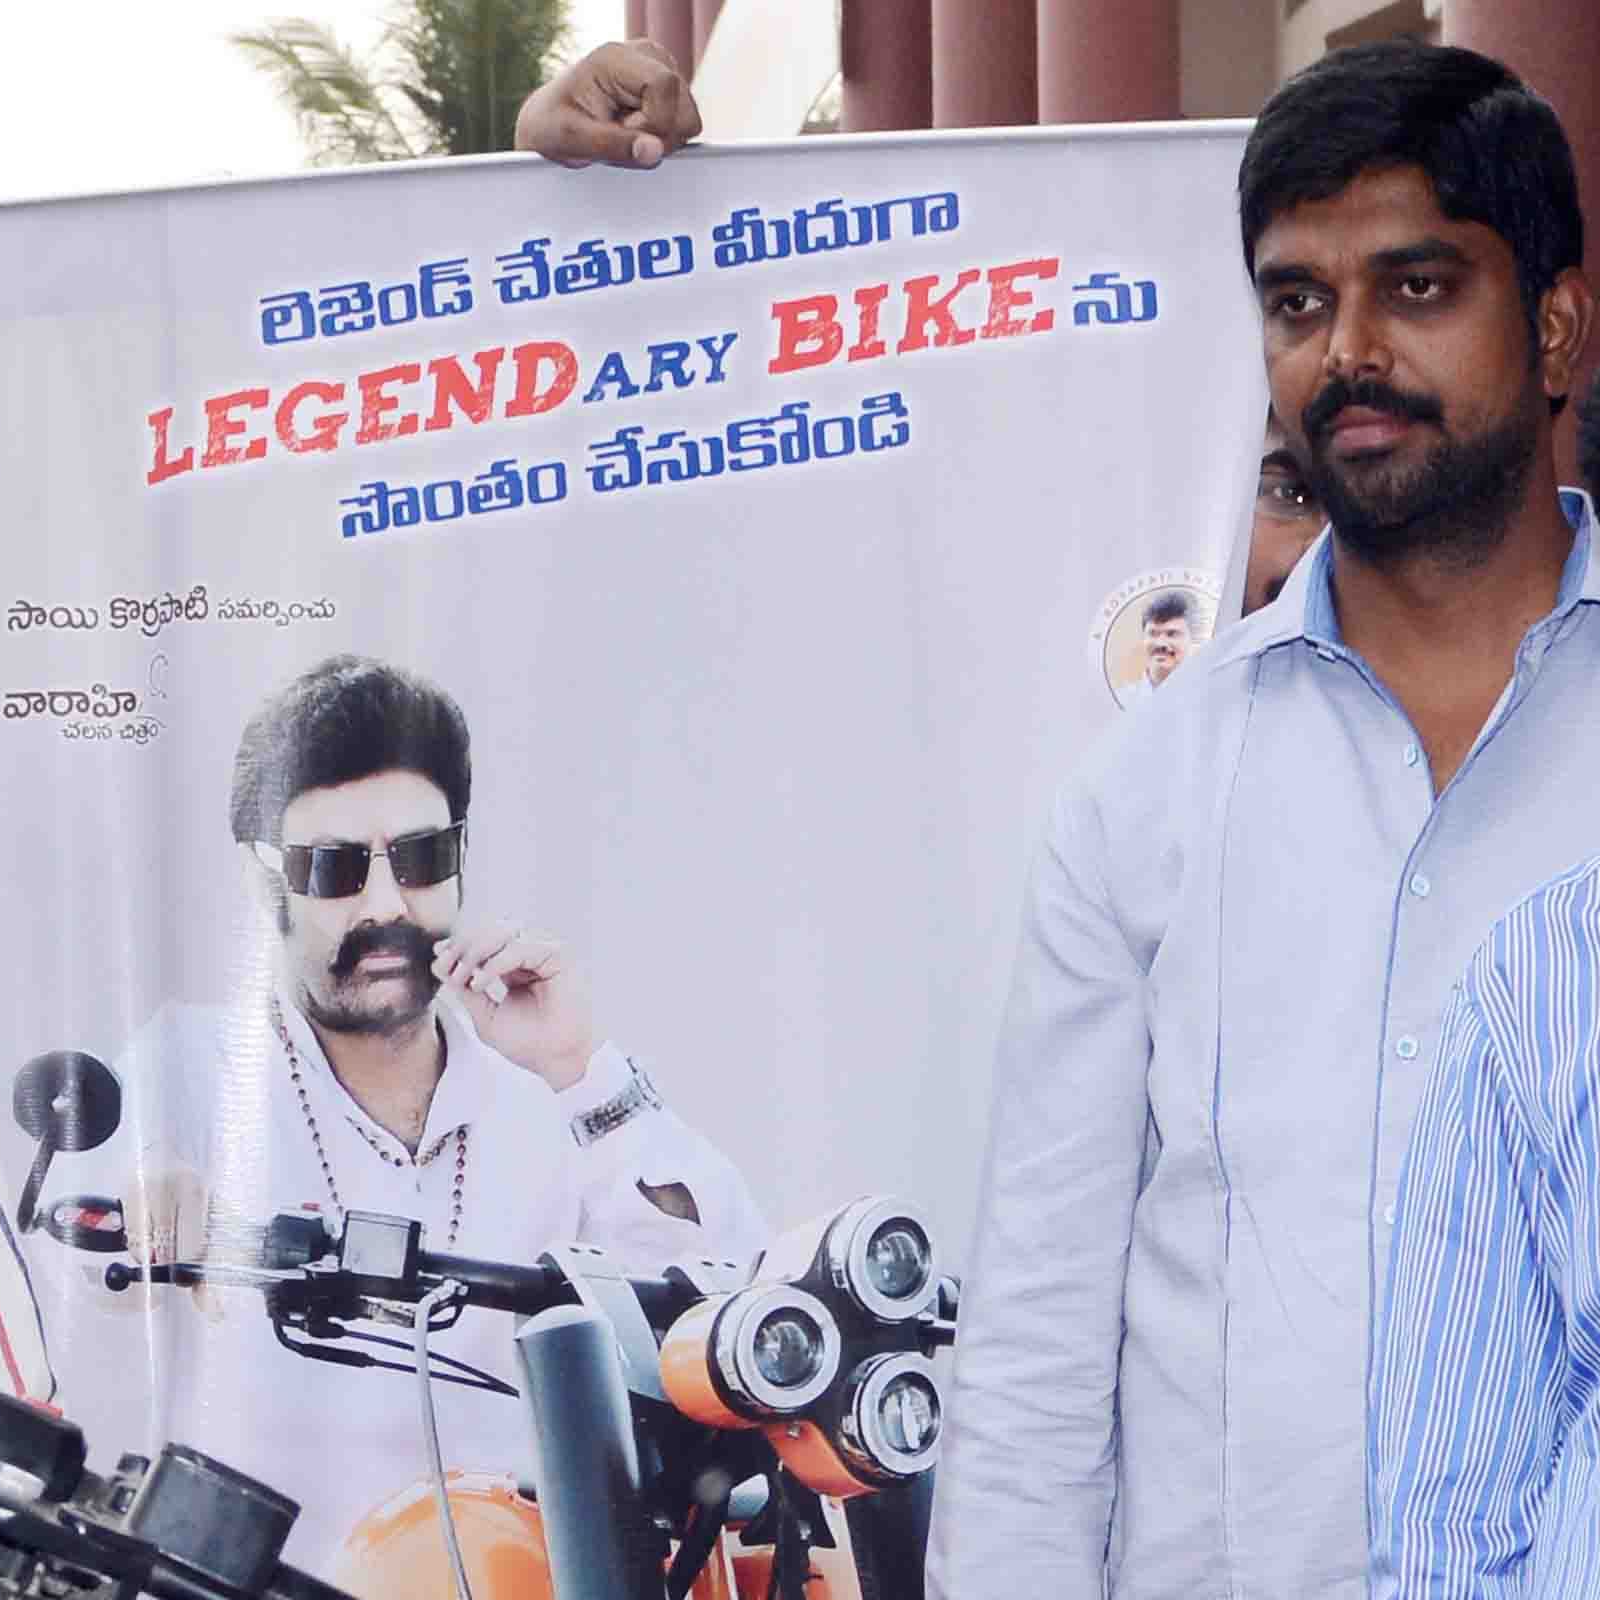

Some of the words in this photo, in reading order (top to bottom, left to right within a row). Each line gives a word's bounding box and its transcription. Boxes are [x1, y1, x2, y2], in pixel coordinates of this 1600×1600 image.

[259, 256, 475, 346] లెజెండ్
[493, 236, 695, 305] చేతుల
[710, 190, 961, 269] మీదుగా
[145, 332, 740, 486] LEGENDARY
[766, 256, 1061, 375] BIKE
[1071, 270, 1160, 327] ను
[338, 458, 568, 540] సొంతం
[585, 391, 912, 494] చేసుకోండి
[6, 599, 99, 631] సాయి
[2, 683, 137, 719] వారాహి
